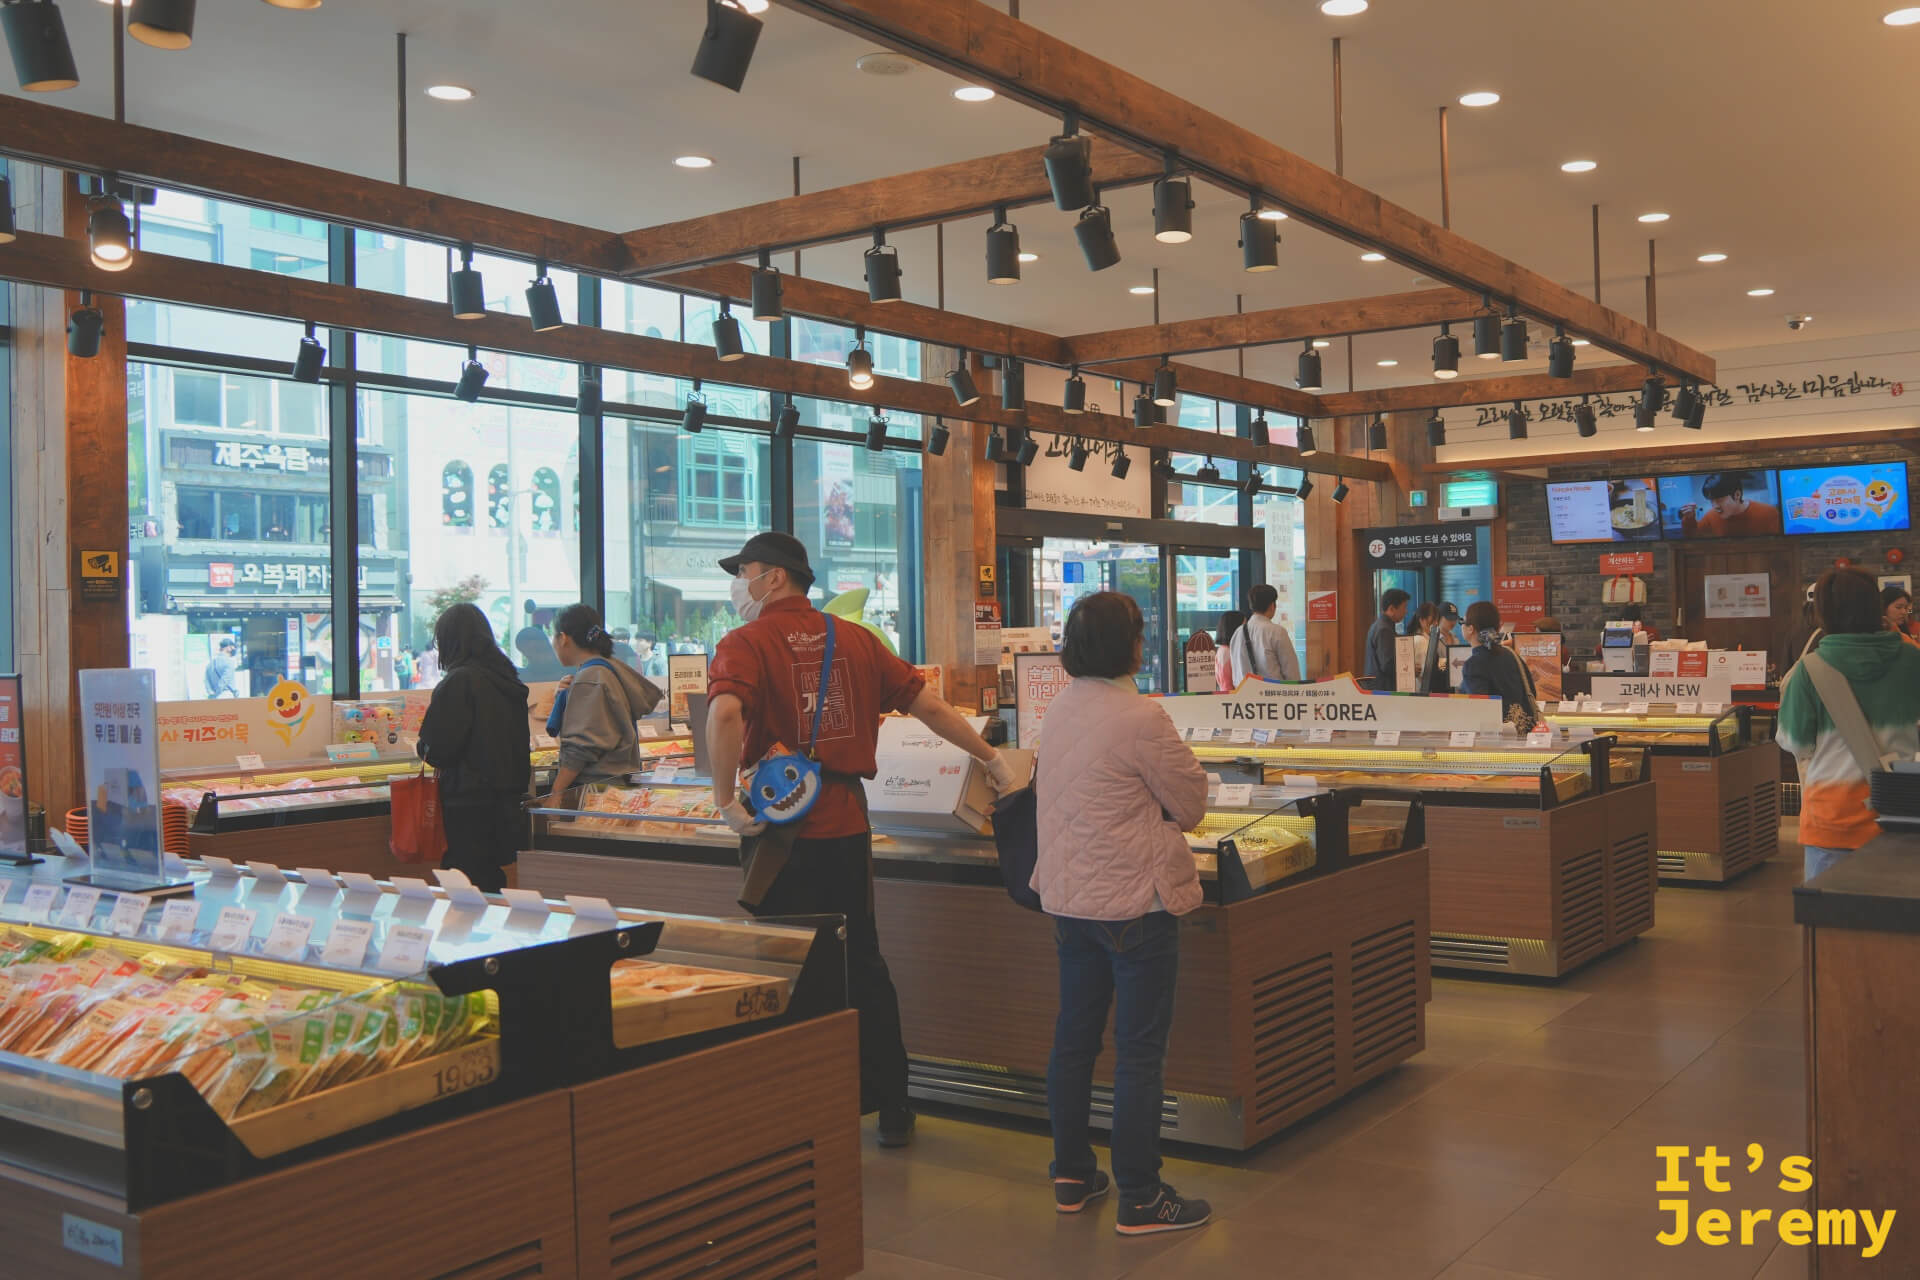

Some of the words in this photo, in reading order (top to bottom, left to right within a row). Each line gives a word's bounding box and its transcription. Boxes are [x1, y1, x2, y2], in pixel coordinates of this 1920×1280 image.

[1802, 371, 1891, 397] 마음입니다
[1440, 534, 1448, 543] 수
[1449, 533, 1473, 543] 있어요
[1370, 544, 1383, 554] 2F
[1619, 683, 1661, 698] 고래사
[1665, 684, 1700, 697] NEW
[1222, 702, 1278, 720] TASTE
[1284, 703, 1307, 720] OF
[1314, 703, 1377, 721] KOREA
[183, 723, 249, 744] 키즈어묵
[432, 1056, 495, 1098] 1963
[1158, 1200, 1181, 1222] N
